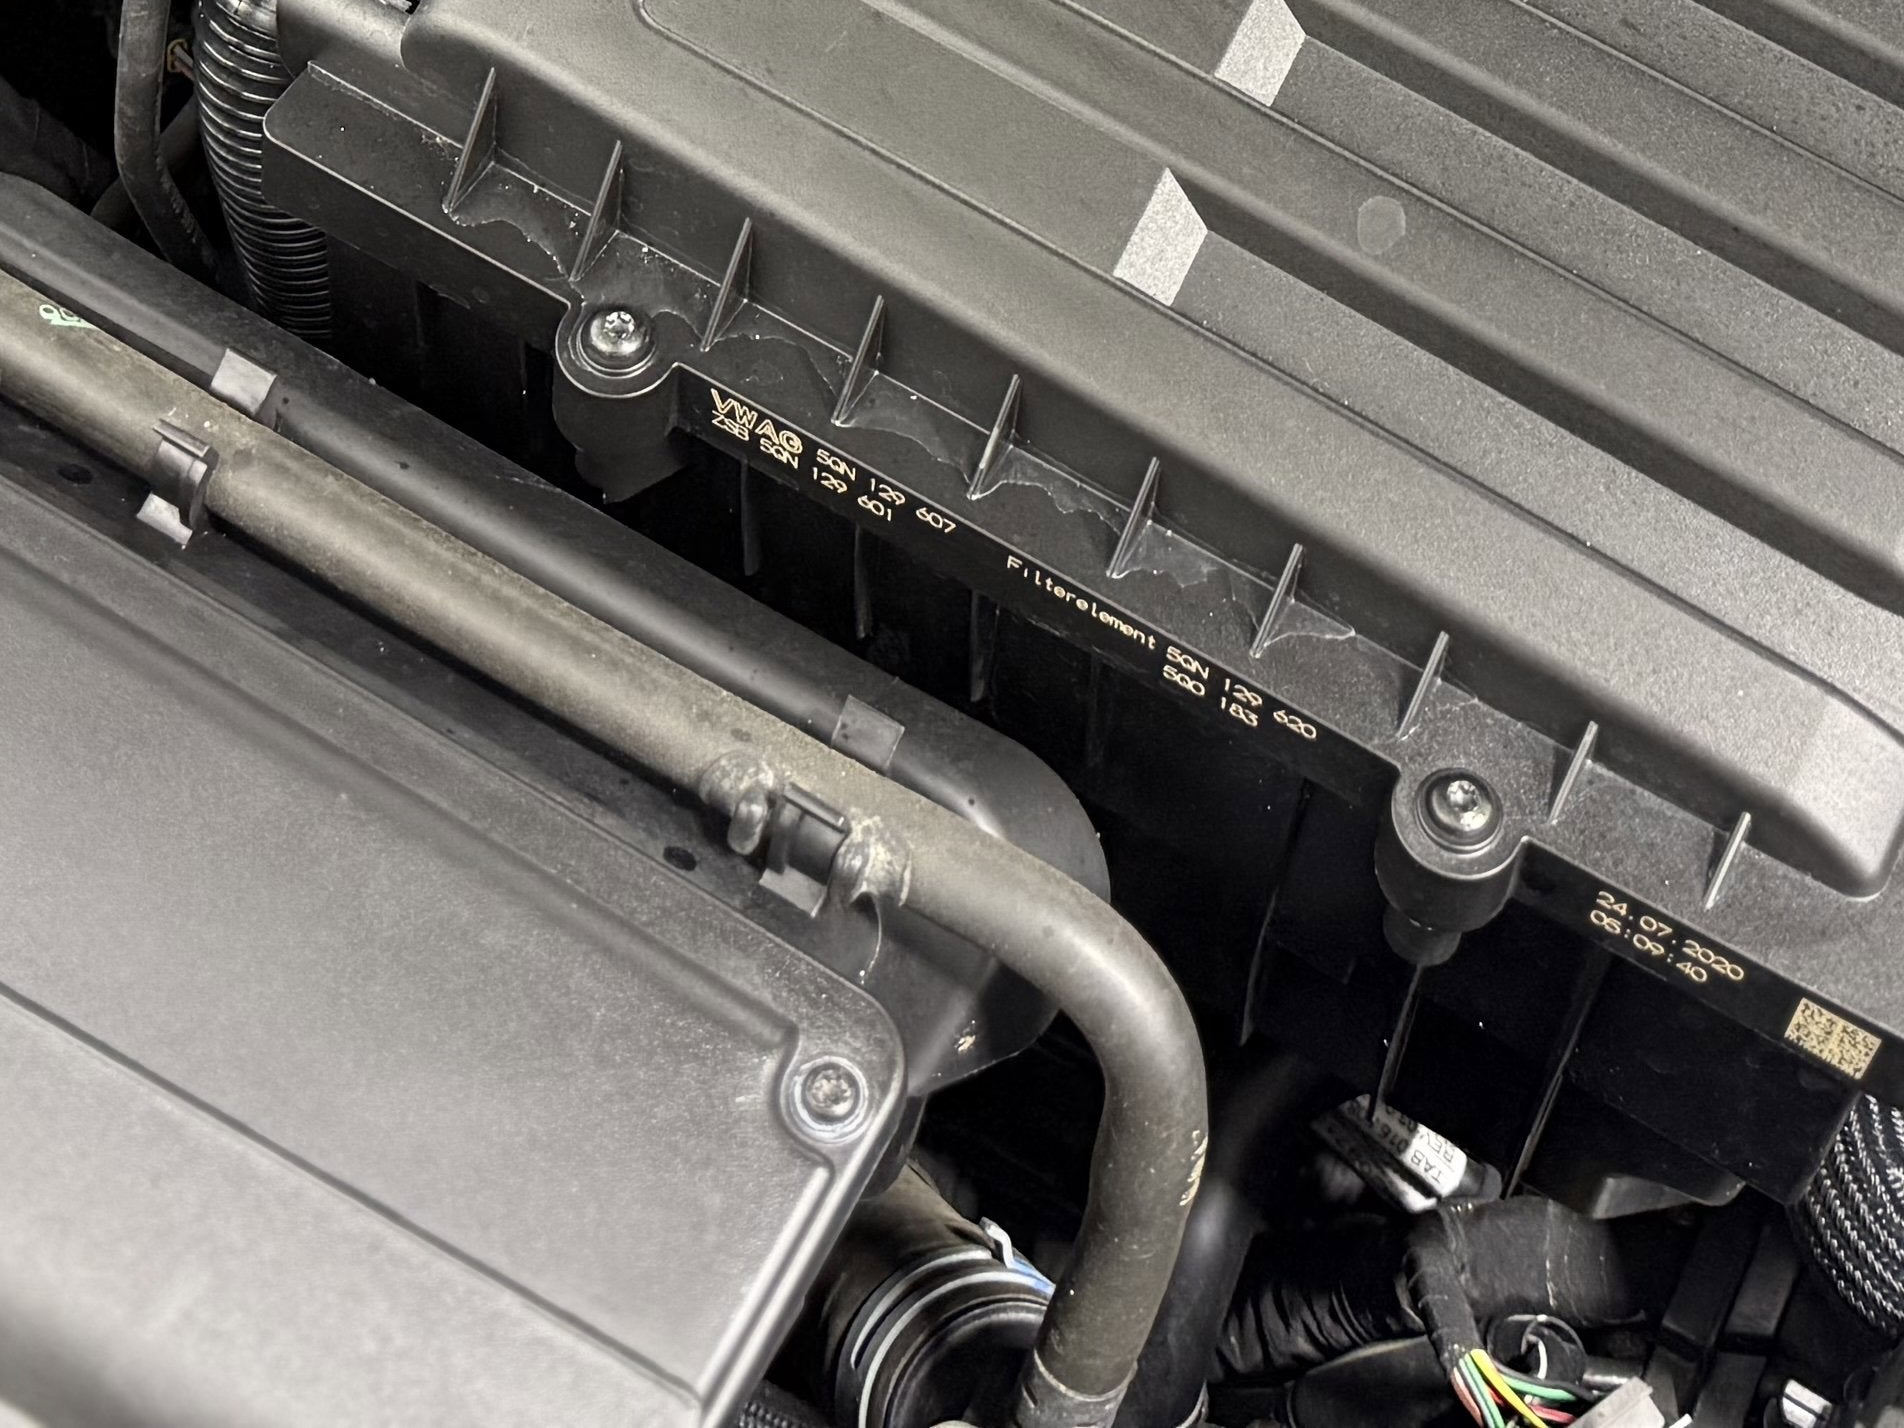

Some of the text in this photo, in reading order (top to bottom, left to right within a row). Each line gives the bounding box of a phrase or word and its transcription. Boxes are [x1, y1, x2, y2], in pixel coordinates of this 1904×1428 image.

[711, 409, 892, 521] ZSB 5QN 129 601
[815, 447, 856, 481] 5QN
[870, 477, 906, 505] 129
[915, 506, 956, 533] 607
[1006, 554, 1317, 739] Filterelement 5QN 129 620
[1220, 696, 1258, 727] 183
[1595, 890, 1744, 980] 24.07.2020
[1410, 1148, 1445, 1185] TAB
